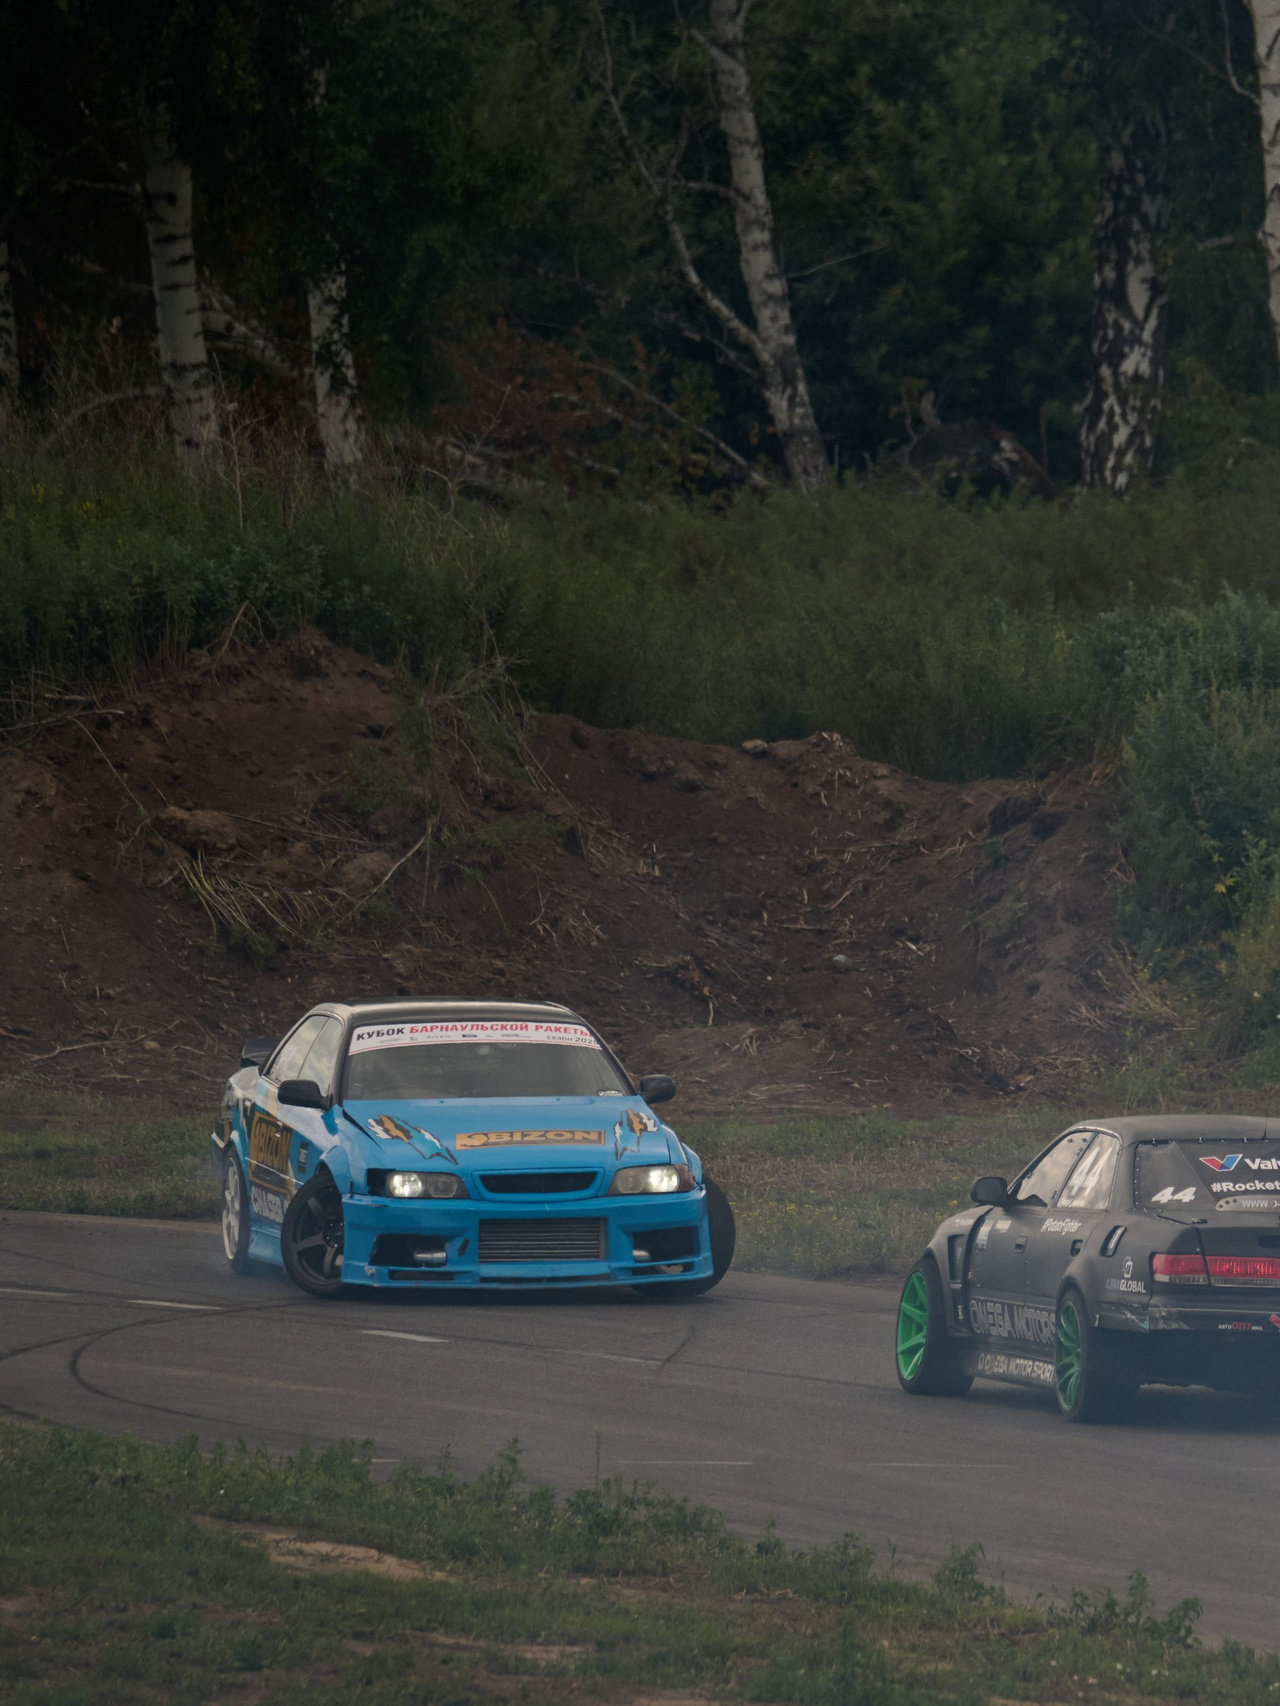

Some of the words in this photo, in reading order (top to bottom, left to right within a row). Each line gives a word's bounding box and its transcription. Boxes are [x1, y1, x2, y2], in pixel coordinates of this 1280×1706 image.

[356, 1027, 405, 1041] КУБОК
[409, 1023, 529, 1034] БАРНАУЛЬСКОЙ
[486, 1130, 599, 1143] BIZON
[1068, 1146, 1113, 1198] 44
[1150, 1186, 1197, 1204] 44
[969, 1299, 1017, 1338] OMEGA
